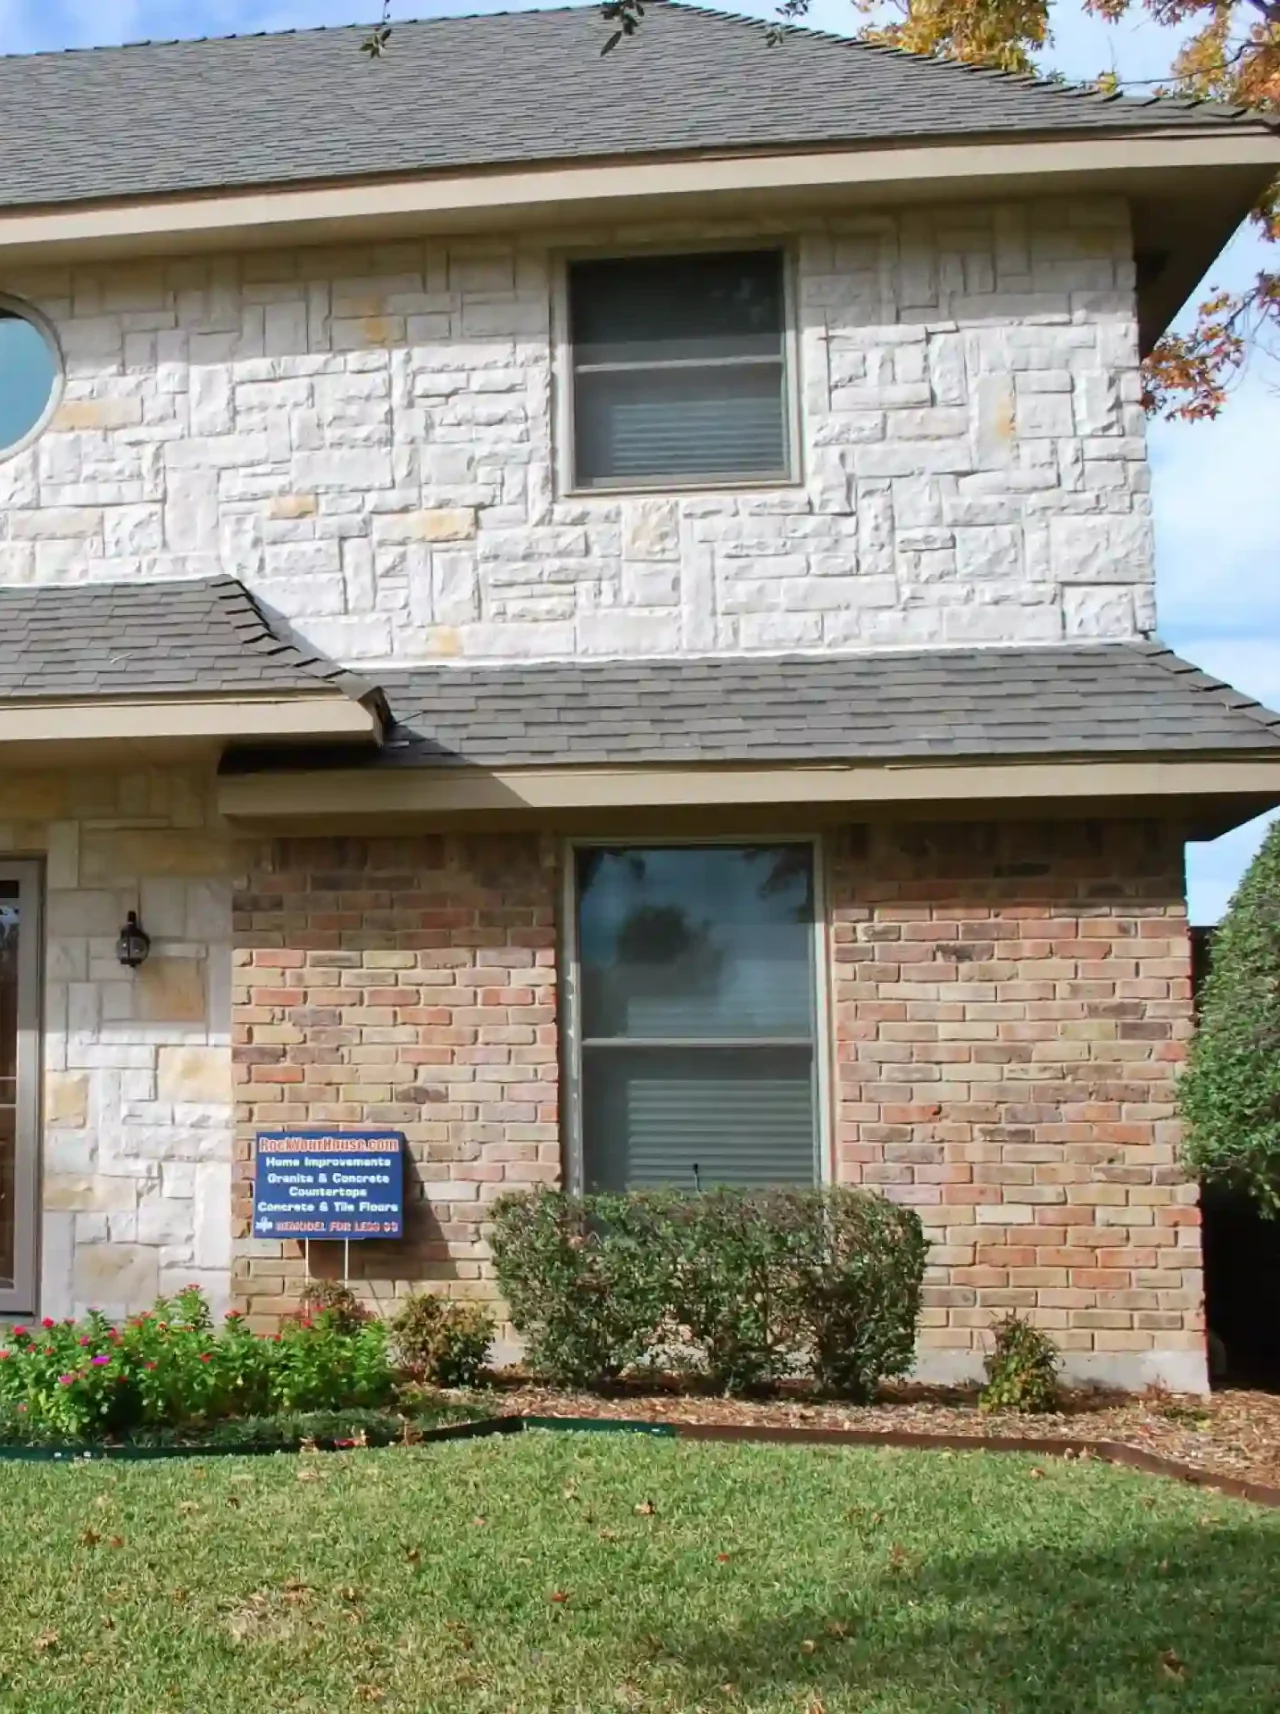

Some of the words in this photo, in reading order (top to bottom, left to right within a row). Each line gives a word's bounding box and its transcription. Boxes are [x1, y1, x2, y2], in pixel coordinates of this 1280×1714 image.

[266, 1157, 300, 1167] Home
[304, 1157, 391, 1169] Improvements
[267, 1173, 314, 1183] Granite
[319, 1173, 327, 1183] &
[332, 1173, 390, 1183] Concrete
[289, 1187, 367, 1198] Countertops
[258, 1202, 314, 1212] Concrete
[319, 1202, 328, 1212] &
[335, 1202, 354, 1212] Tile
[359, 1202, 398, 1212] Floors
[330, 1221, 351, 1232] FOR
